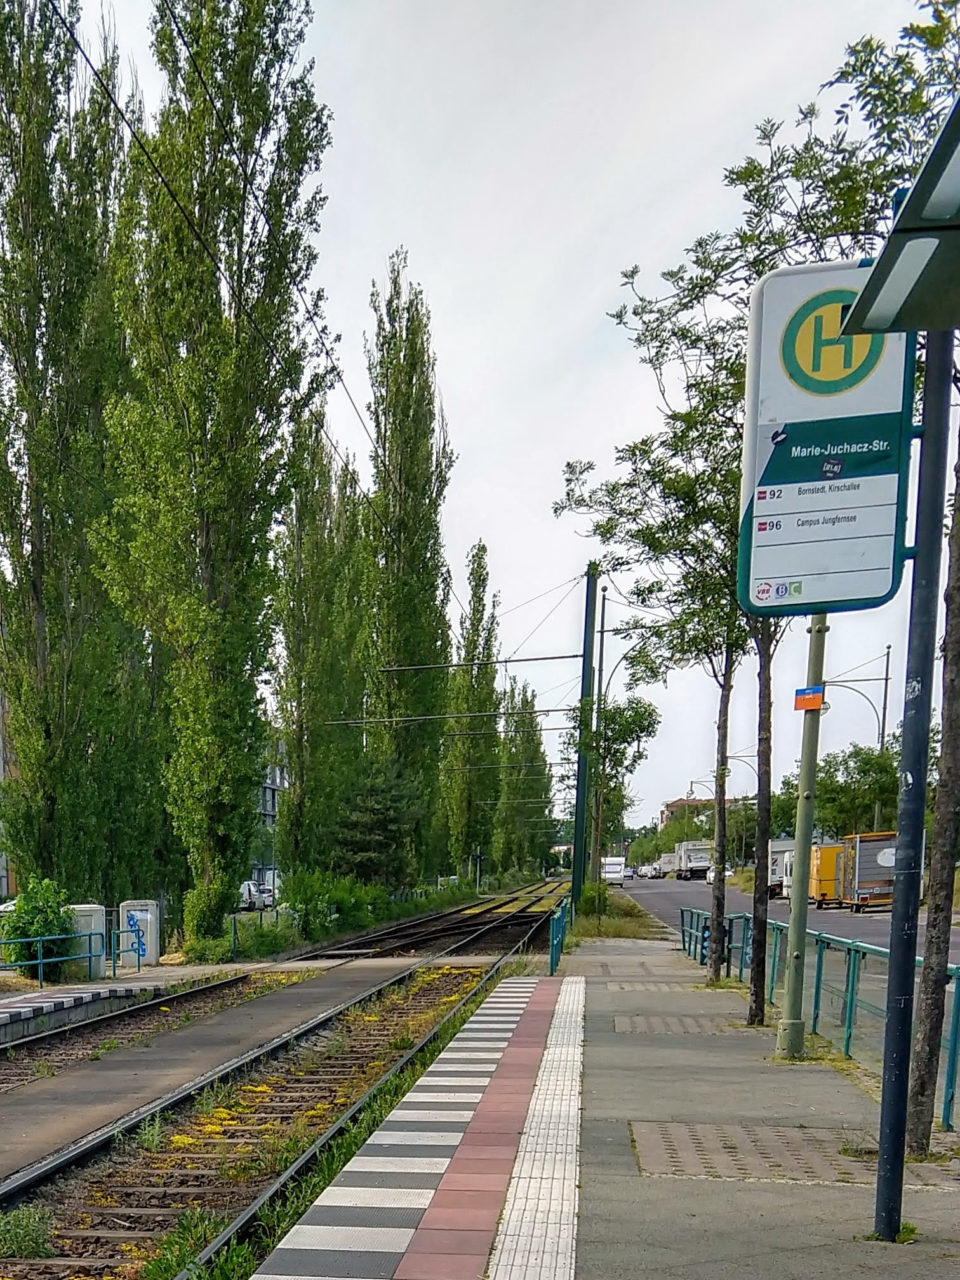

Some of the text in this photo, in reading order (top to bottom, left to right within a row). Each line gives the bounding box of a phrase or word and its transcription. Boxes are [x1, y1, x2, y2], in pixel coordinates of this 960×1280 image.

[812, 314, 853, 372] H
[791, 440, 890, 457] Marie-Juchacz-Str.
[769, 489, 783, 500] 92
[768, 520, 782, 531] 96
[796, 517, 820, 527] Campus
